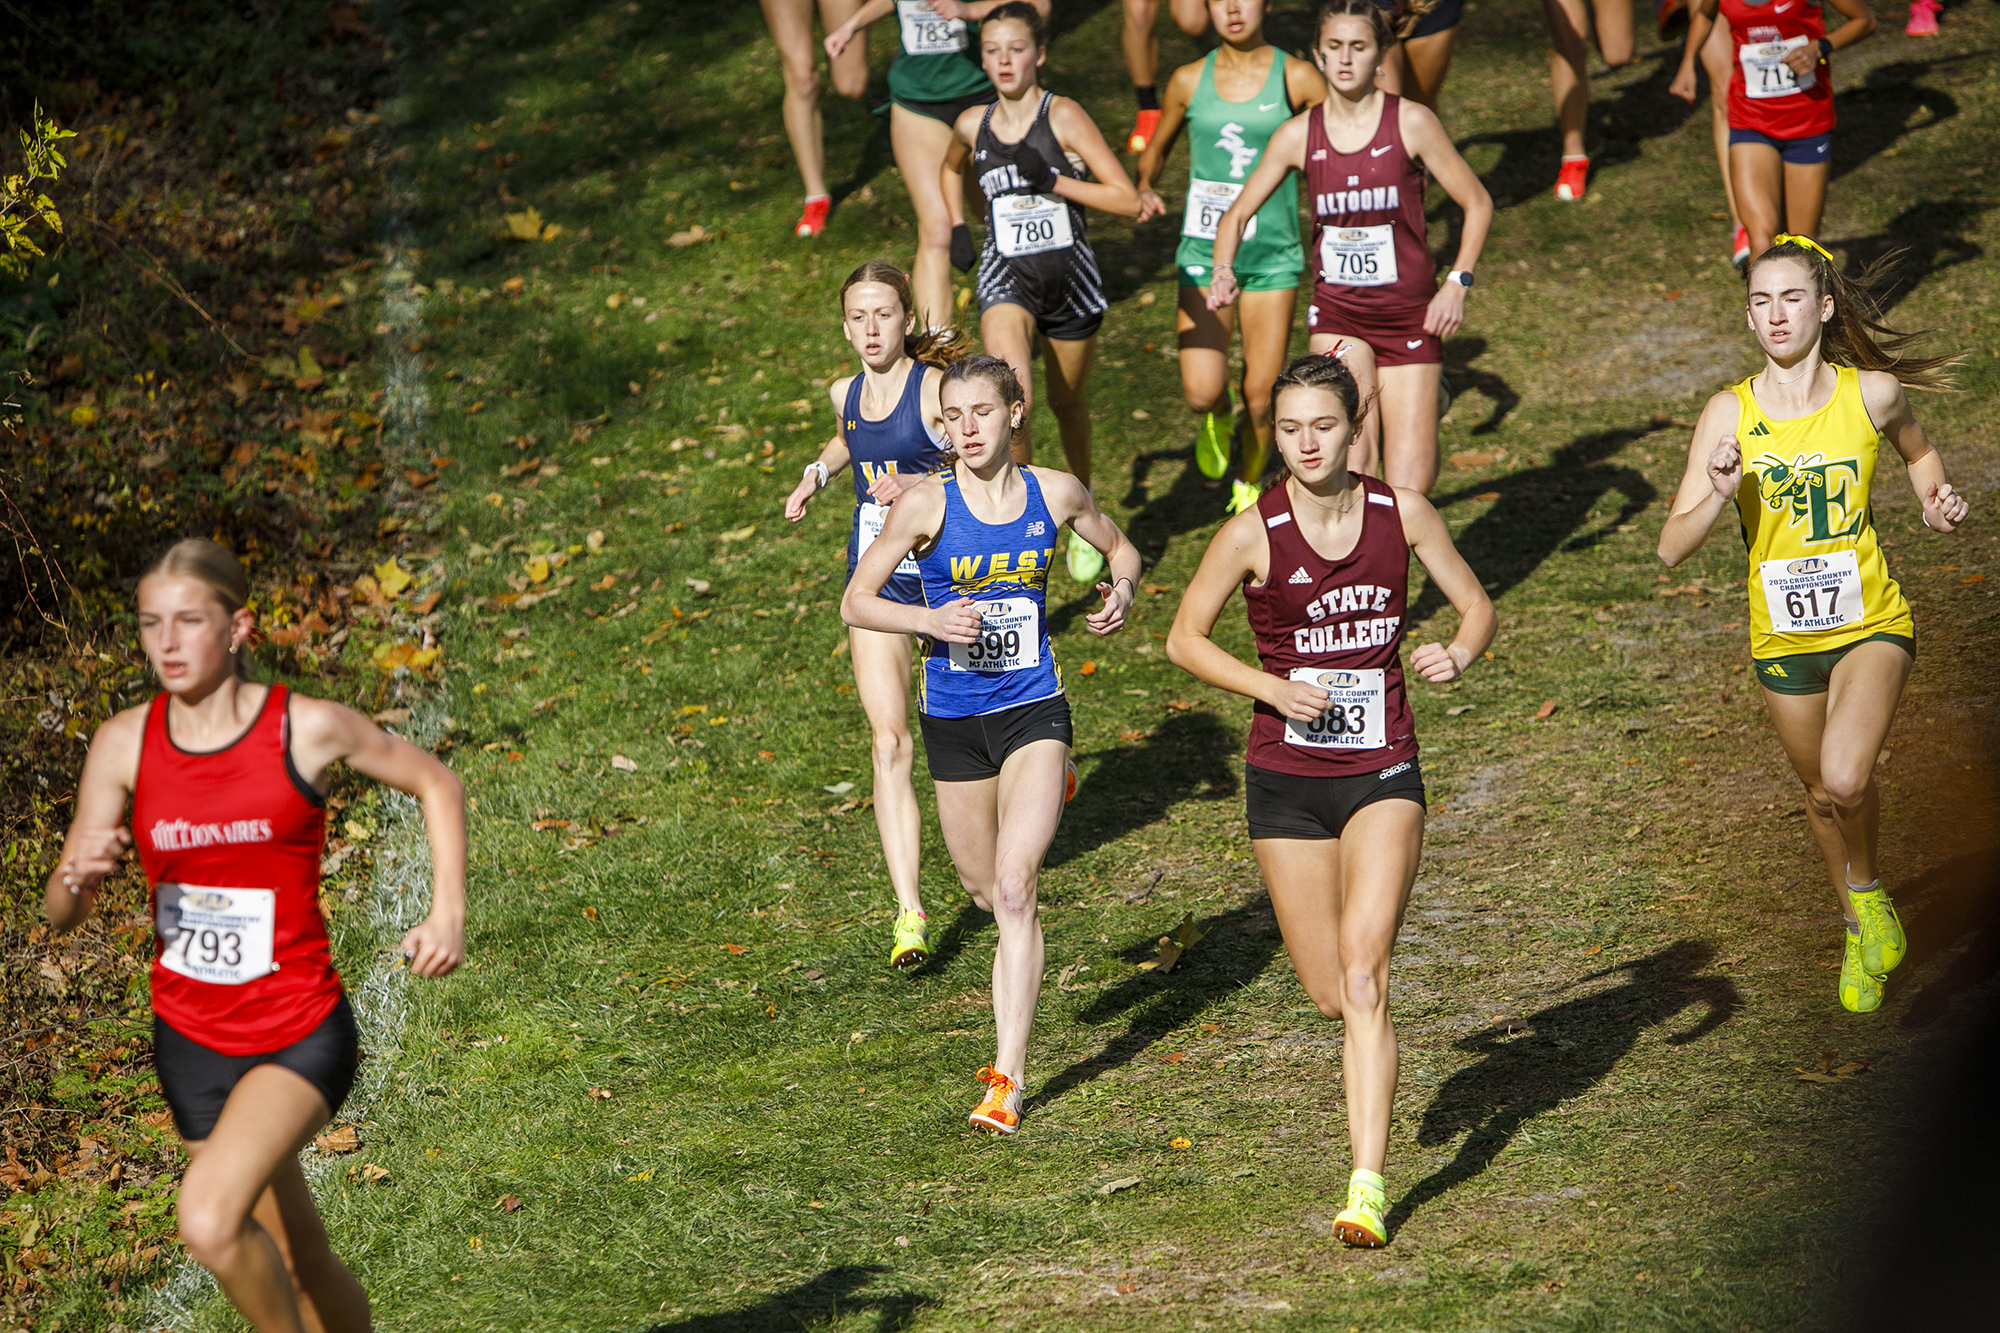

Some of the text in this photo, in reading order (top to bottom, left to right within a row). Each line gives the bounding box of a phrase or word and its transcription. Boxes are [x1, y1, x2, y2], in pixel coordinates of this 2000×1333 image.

[915, 22, 951, 42] 783
[1316, 185, 1399, 216] ALTOONA
[1200, 205, 1225, 227] 67
[1011, 218, 1054, 244] 780
[1336, 253, 1378, 274] 705
[950, 548, 1055, 583] WEST
[1780, 578, 1843, 591] CHAMPIONSHIPS
[1789, 576, 1815, 585] CROSS
[1816, 570, 1853, 581] COUNTRY
[1306, 585, 1392, 623] STATE
[1785, 586, 1840, 619] 617
[1000, 615, 1032, 624] COUNTRY
[1804, 614, 1845, 628] ATHLETIC
[967, 630, 1020, 661] 599
[1294, 616, 1400, 654] COLLEGE
[982, 658, 1020, 669] ATHLETIC
[1329, 689, 1379, 697] OSS COUNTRY
[1320, 735, 1364, 744] ATHLETIC
[1379, 762, 1411, 780] adidas
[178, 927, 241, 966] 793
